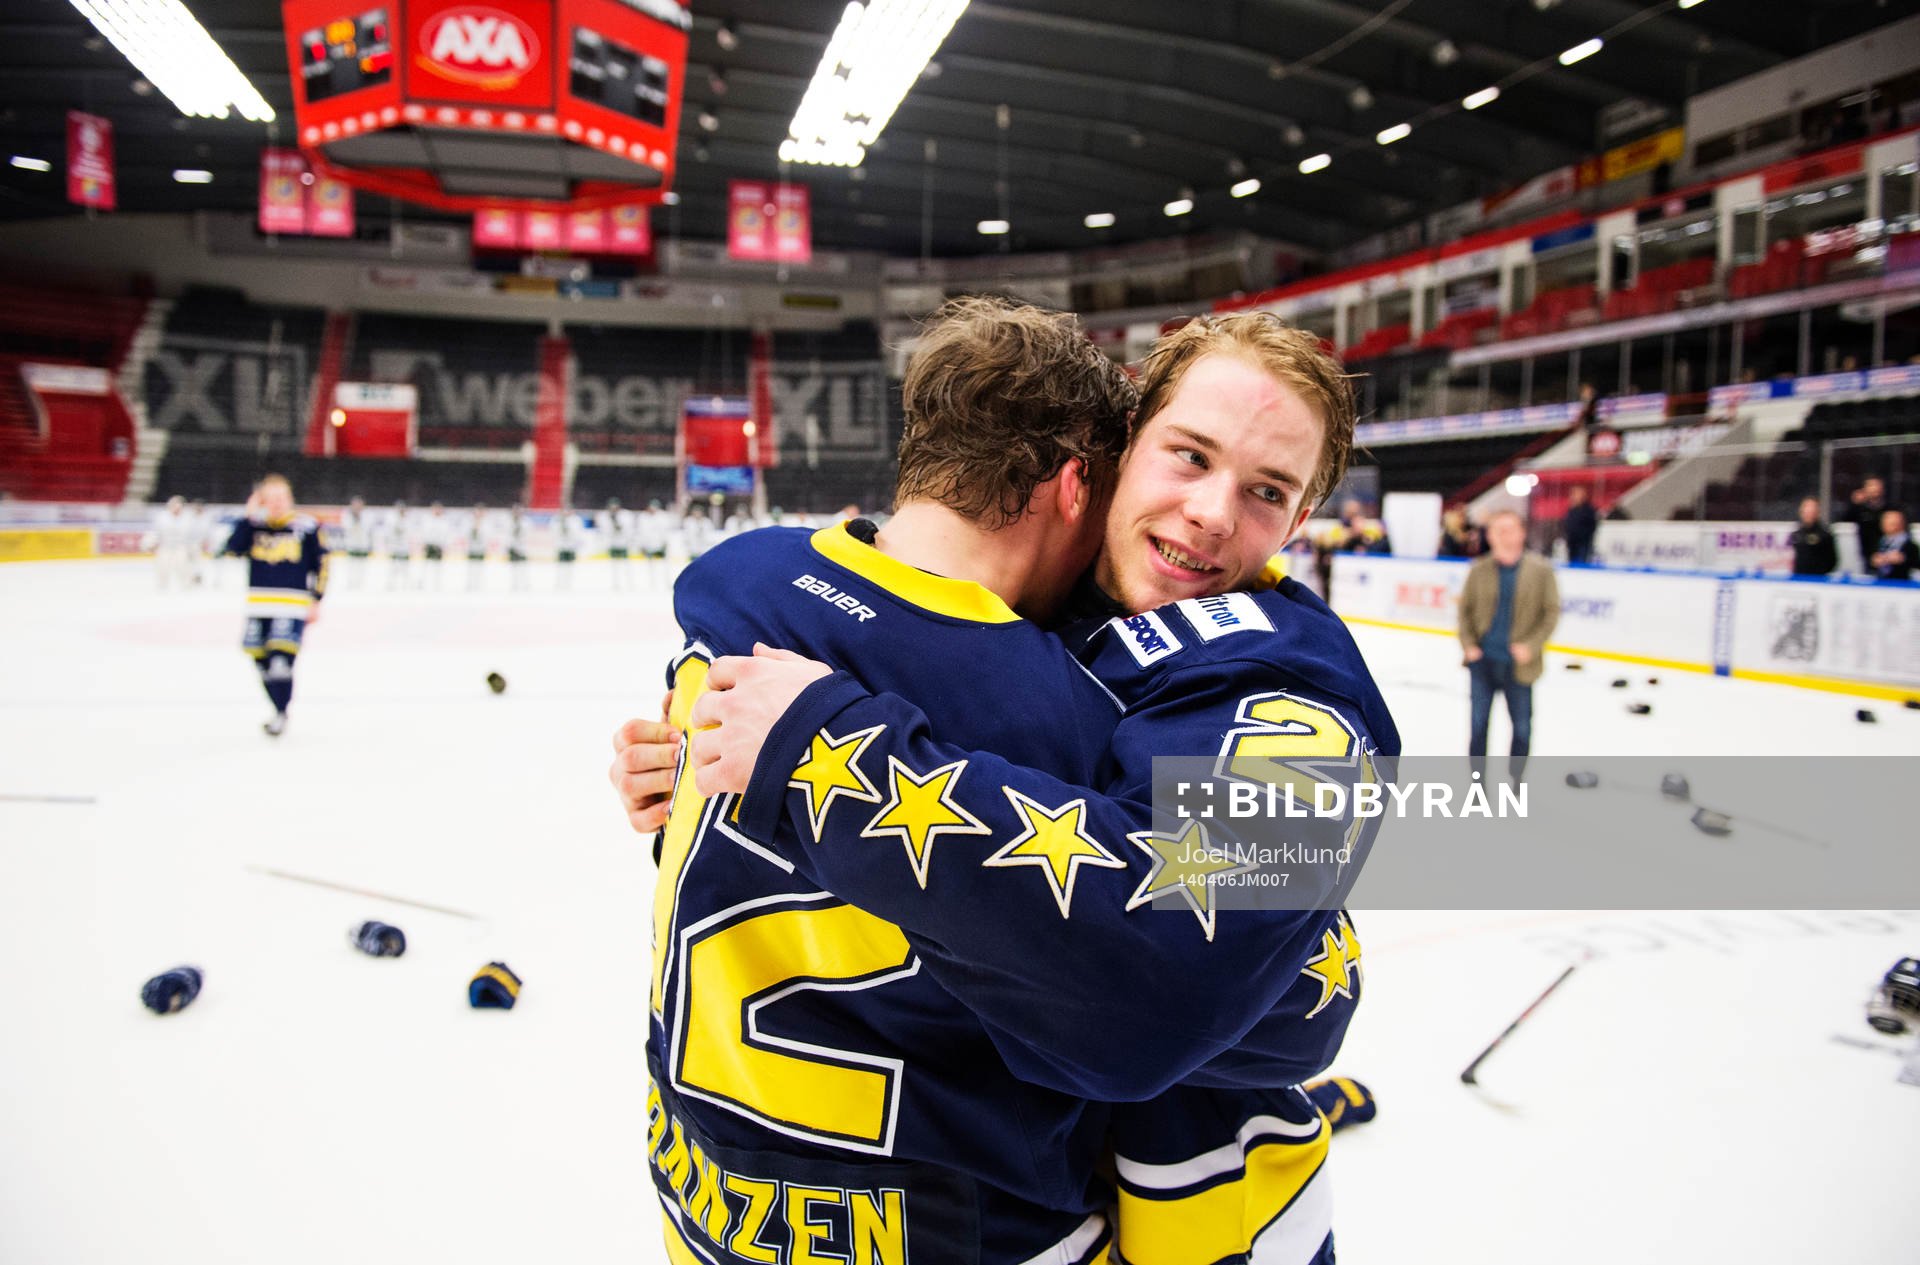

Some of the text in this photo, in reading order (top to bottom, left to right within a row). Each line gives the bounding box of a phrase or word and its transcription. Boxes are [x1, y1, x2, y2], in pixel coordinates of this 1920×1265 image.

[431, 15, 530, 69] AXA
[791, 574, 877, 622] BAUER
[647, 1076, 909, 1265] RANZEN
